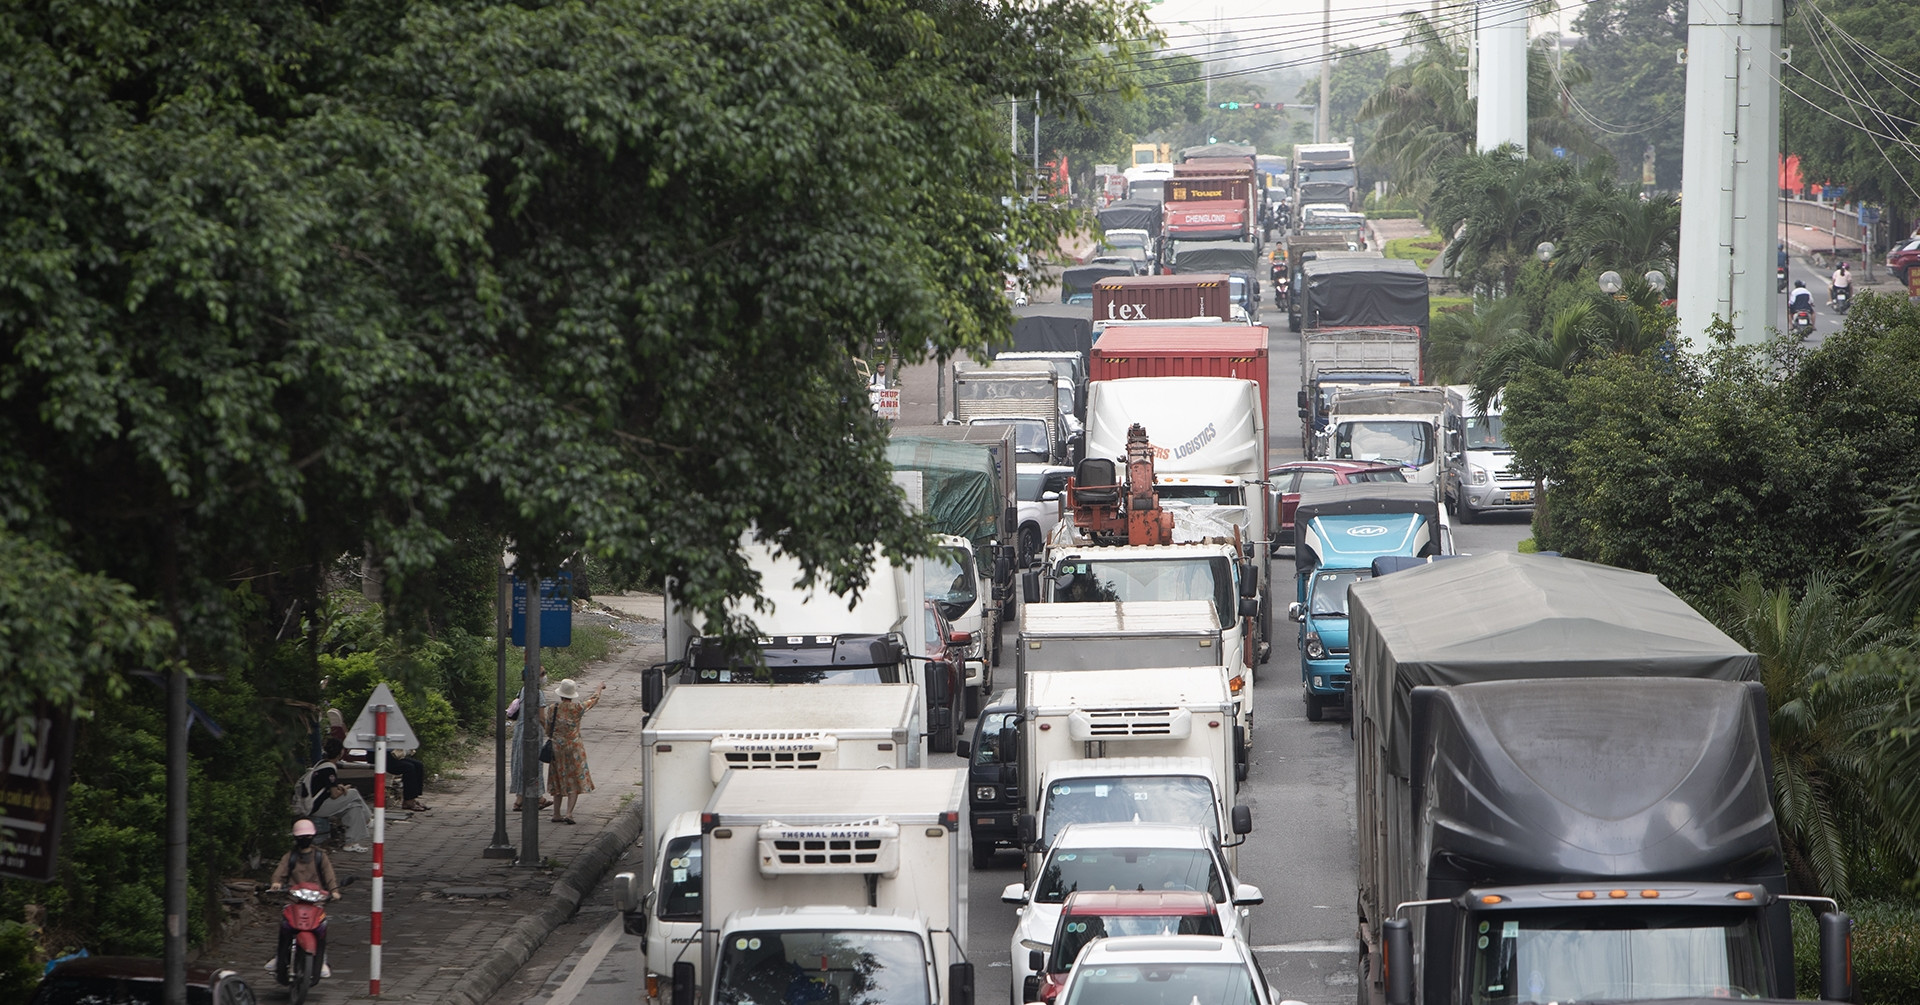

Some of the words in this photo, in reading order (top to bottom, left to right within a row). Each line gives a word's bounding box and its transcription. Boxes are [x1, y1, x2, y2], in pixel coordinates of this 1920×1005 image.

[1185, 214, 1226, 223] CHENGLONG
[1107, 299, 1147, 320] tex
[1173, 422, 1217, 460] LOGISTICS
[781, 831, 828, 839] THERMAL
